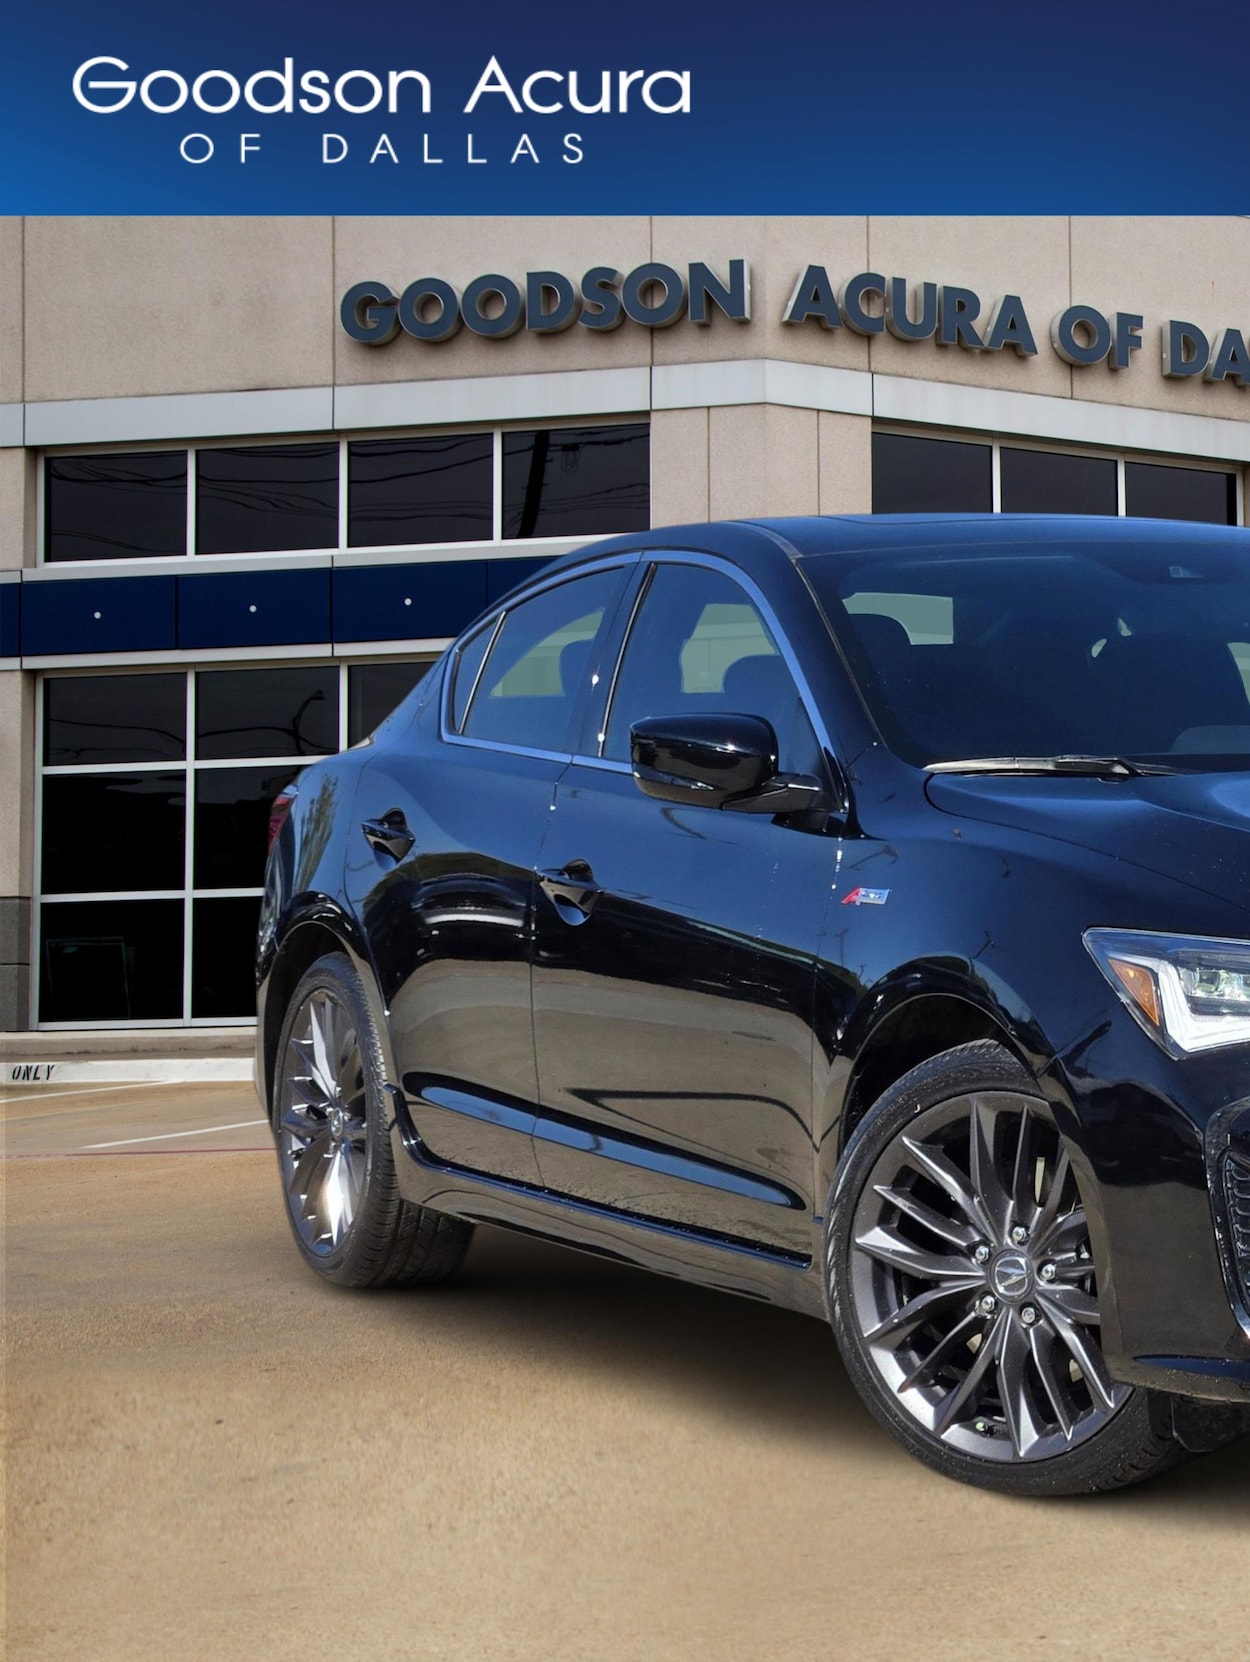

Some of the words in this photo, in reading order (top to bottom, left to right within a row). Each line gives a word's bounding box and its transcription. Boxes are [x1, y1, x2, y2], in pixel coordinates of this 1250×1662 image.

[339, 258, 752, 346] GOODSON
[781, 264, 1038, 358] ACURA
[1052, 304, 1144, 370] OF
[11, 1064, 56, 1081] ONLY
